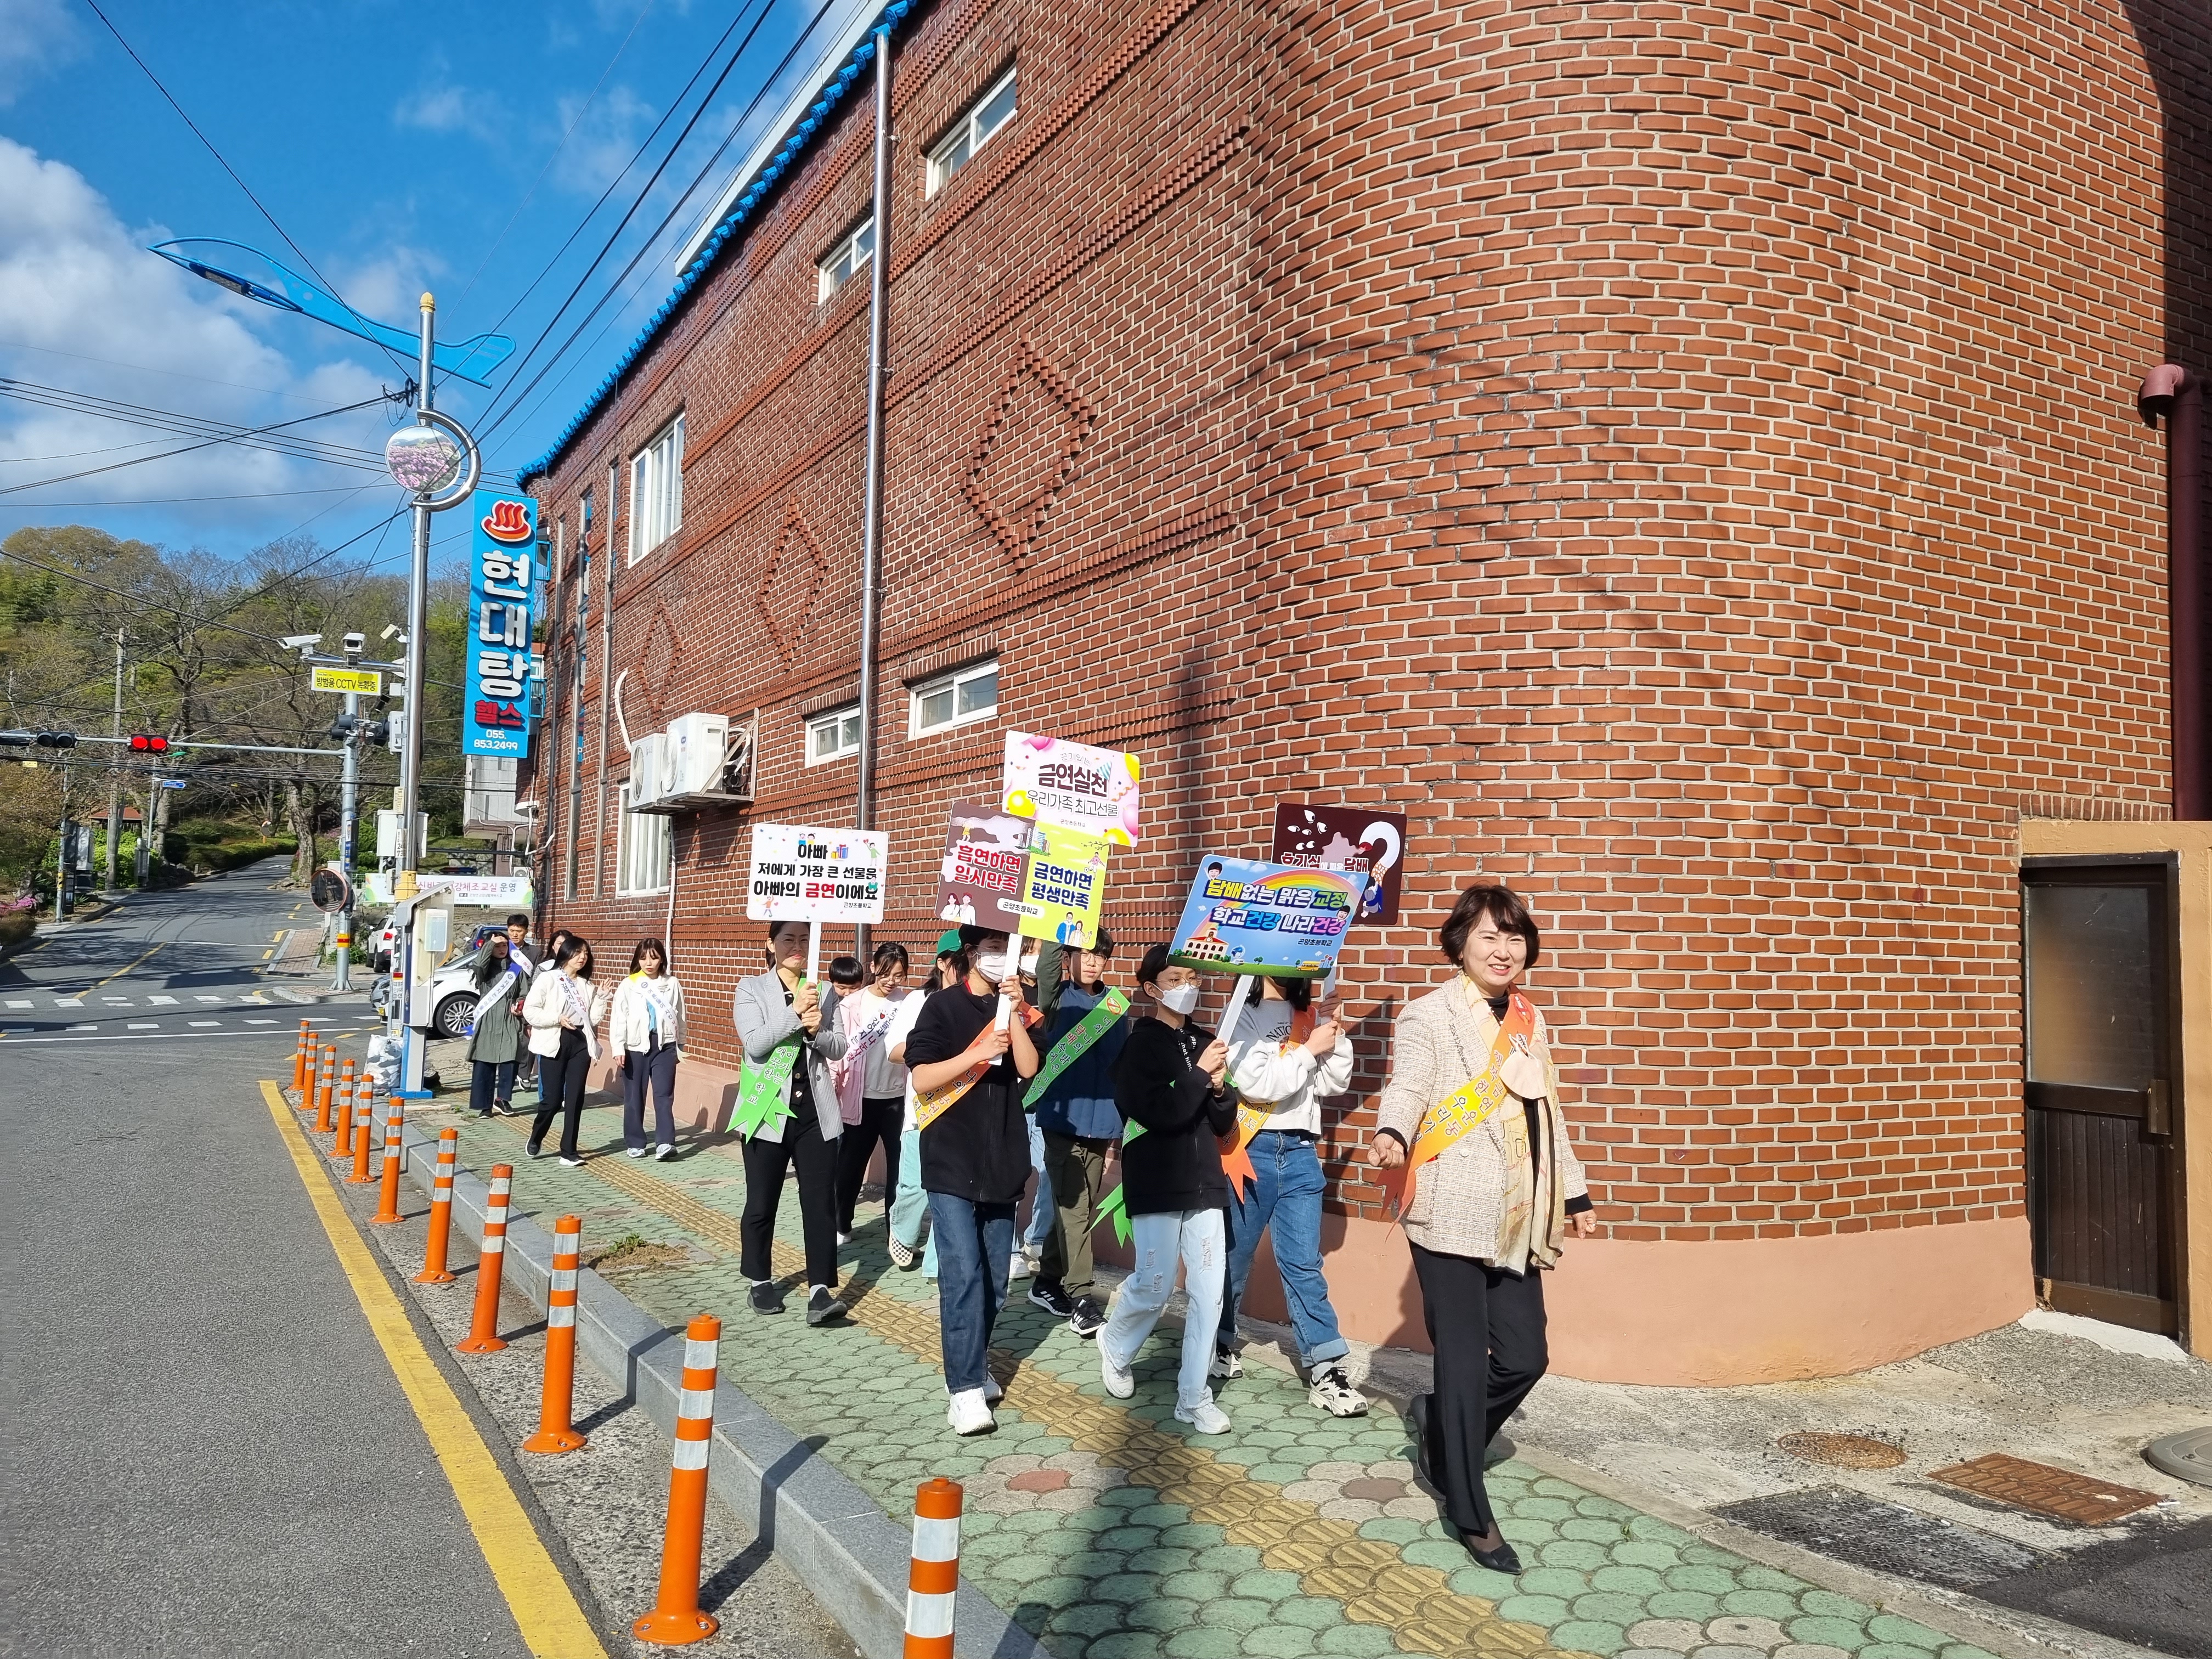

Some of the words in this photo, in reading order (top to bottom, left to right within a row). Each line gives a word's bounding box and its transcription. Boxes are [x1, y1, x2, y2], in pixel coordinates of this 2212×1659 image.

[478, 550, 531, 697] 현대탕
[317, 677, 335, 687] 방범용
[336, 679, 357, 689] CCTV
[475, 700, 521, 726] 헬스
[1039, 764, 1107, 797] 금연실천
[1027, 790, 1073, 812] 우리가족
[1075, 798, 1118, 816] 최고선물
[798, 844, 828, 859] 아빠
[958, 845, 1022, 873] 흡연하면
[1344, 857, 1369, 873] 담배
[758, 863, 795, 876] 저에게
[799, 865, 824, 877] 가장
[827, 866, 838, 878] 큰
[843, 867, 877, 879] 선물은
[954, 866, 1019, 895] 일시만족
[1034, 862, 1092, 890] 금연하면
[448, 882, 498, 891] 강체조교실
[500, 883, 516, 892] 운영
[754, 881, 800, 897] 아빠의
[1031, 882, 1090, 910] 평생만족
[1206, 879, 1276, 903] 담배없는
[1277, 888, 1313, 906] 맑은
[1313, 890, 1348, 908] 교정
[1003, 901, 1039, 915] 곤양초등학교
[1212, 906, 1281, 929] 학교건강
[1282, 914, 1346, 934] 나라건강
[765, 1047, 787, 1080] 깨끗한
[747, 1082, 765, 1105] 학교
[1445, 1081, 1504, 1136] 금연운동
